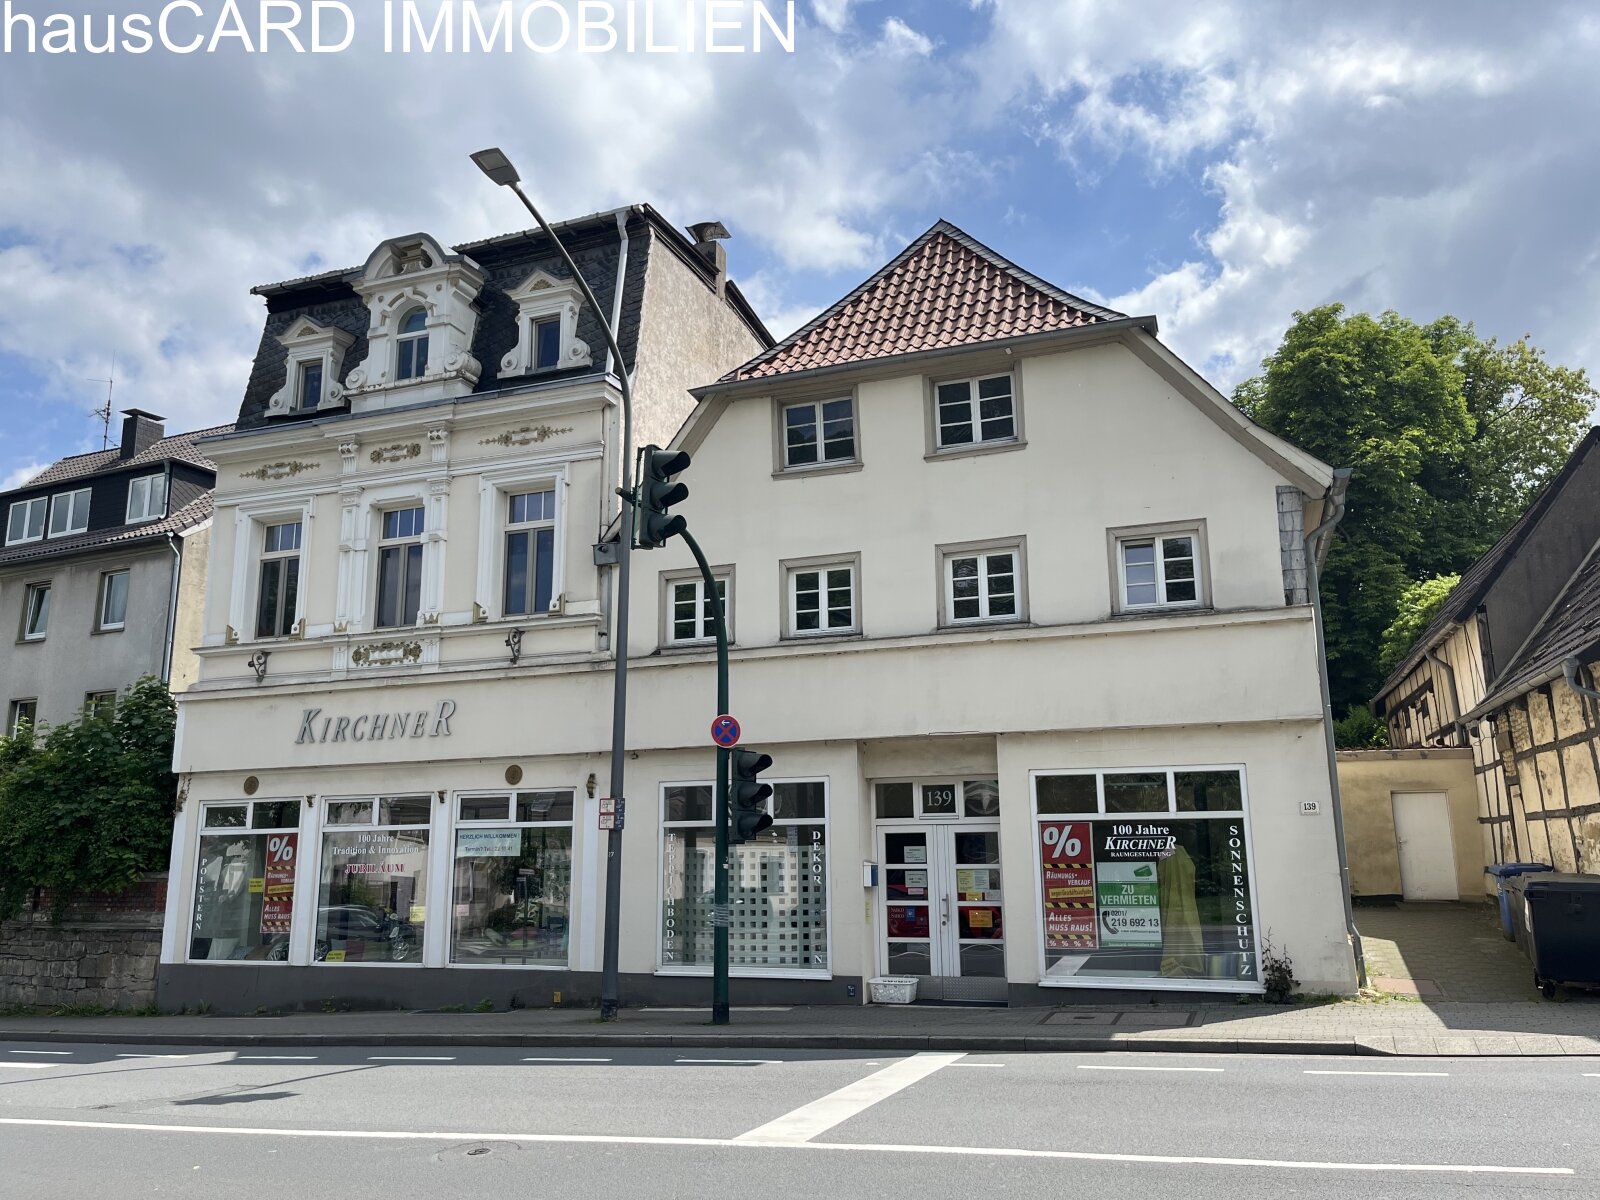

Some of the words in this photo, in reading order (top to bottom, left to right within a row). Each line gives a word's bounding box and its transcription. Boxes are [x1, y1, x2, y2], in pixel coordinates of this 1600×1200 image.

[295, 700, 456, 744] KIRCHNER
[927, 790, 952, 807] 139
[1303, 802, 1317, 811] 139
[1112, 825, 1133, 835] 100
[1135, 825, 1170, 835] Jahre
[357, 834, 371, 843] 100
[372, 833, 395, 843] Jahre
[1043, 825, 1082, 858] %
[1104, 836, 1177, 850] KIRCHNER
[269, 836, 294, 862] %
[333, 846, 367, 855] Tradition
[368, 846, 376, 854] &
[378, 844, 419, 854] Innovation
[345, 861, 407, 874] JUBILÄUM
[195, 858, 208, 931] POLSTERN
[1121, 884, 1135, 895] ZU
[666, 833, 676, 961] TEPPICHBODEN
[1100, 895, 1157, 905] VERMIETEN
[1228, 825, 1252, 976] SONNENSCHUTZ
[1048, 912, 1072, 922] ALLES
[1111, 918, 1128, 927] 219
[1130, 918, 1146, 927] 692
[1148, 918, 1160, 927] 13
[1070, 922, 1093, 932] RAUS!
